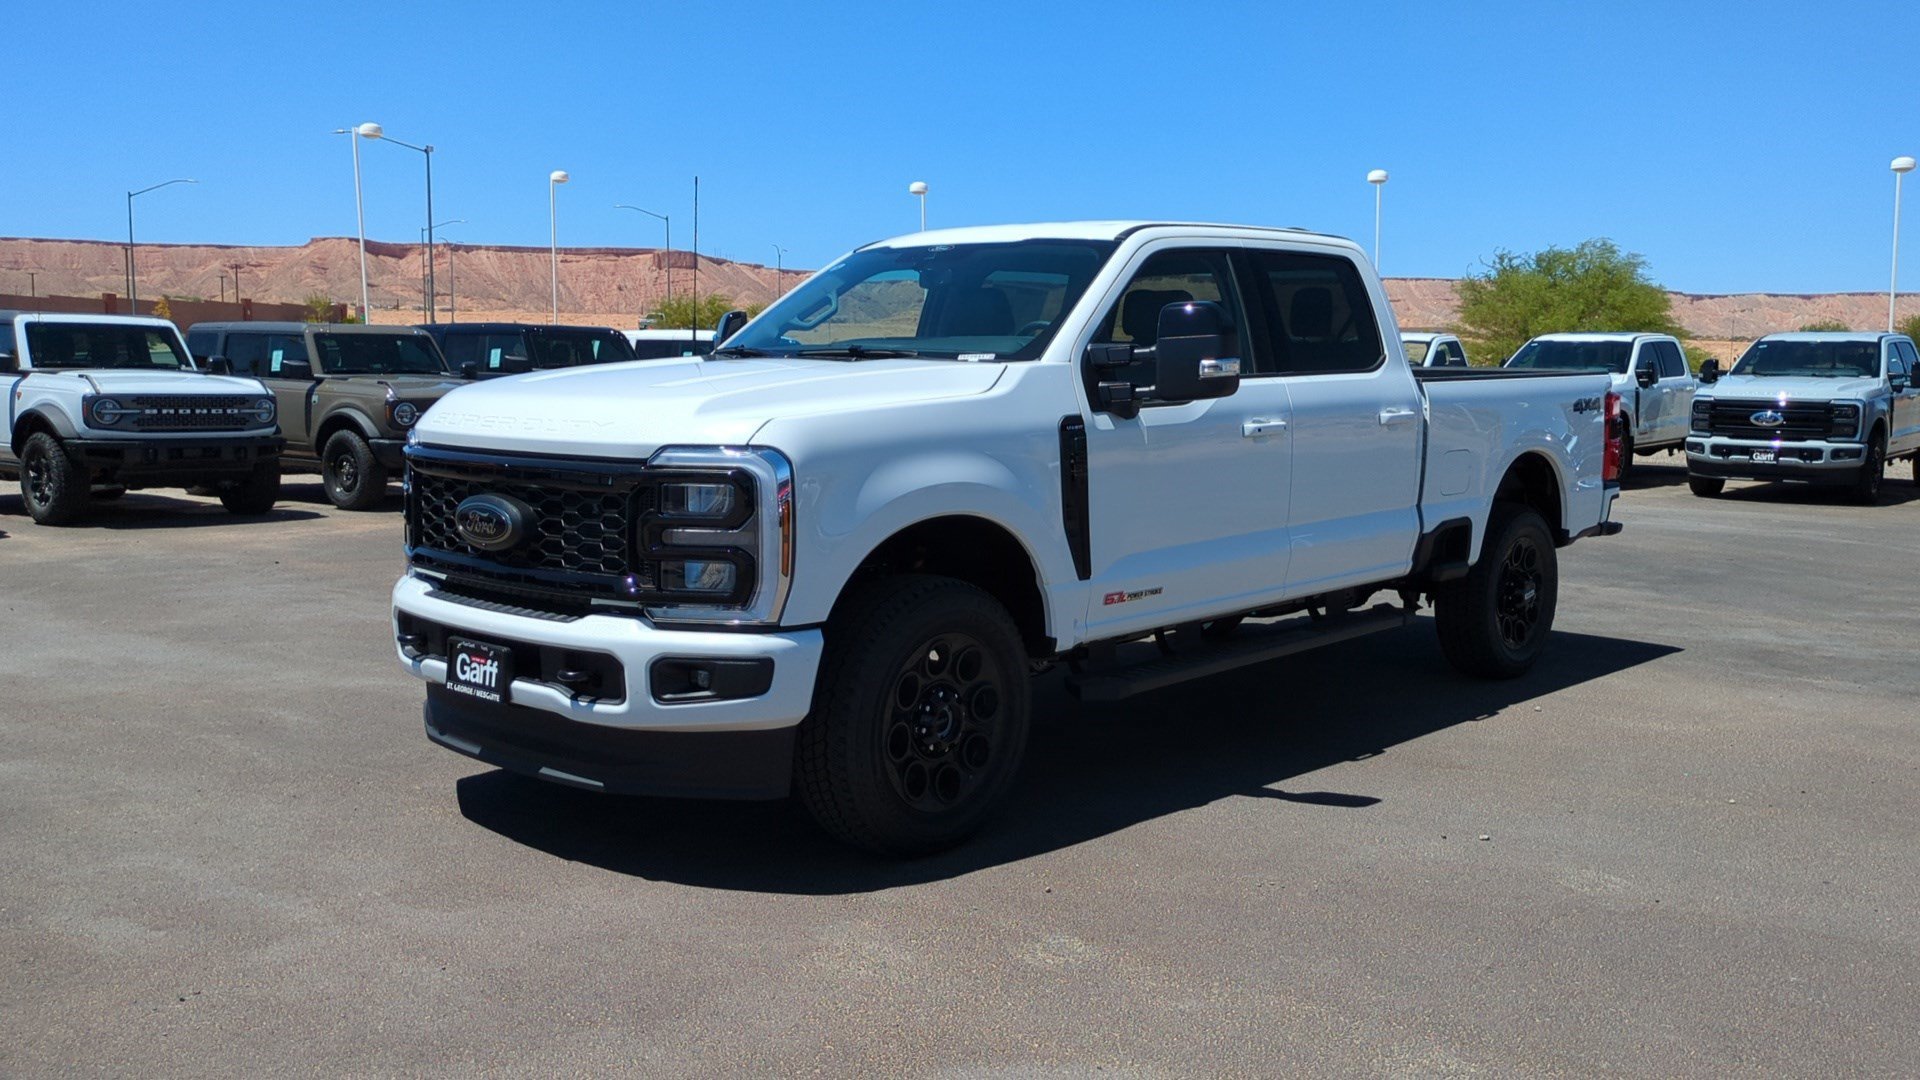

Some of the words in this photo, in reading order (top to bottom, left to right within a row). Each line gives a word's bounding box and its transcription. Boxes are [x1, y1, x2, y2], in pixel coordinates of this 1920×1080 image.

[432, 411, 518, 430] SUPER
[522, 416, 615, 432] DUTY
[466, 510, 496, 534] Ford
[456, 652, 498, 688] Garff
[454, 683, 473, 695] GEORGE
